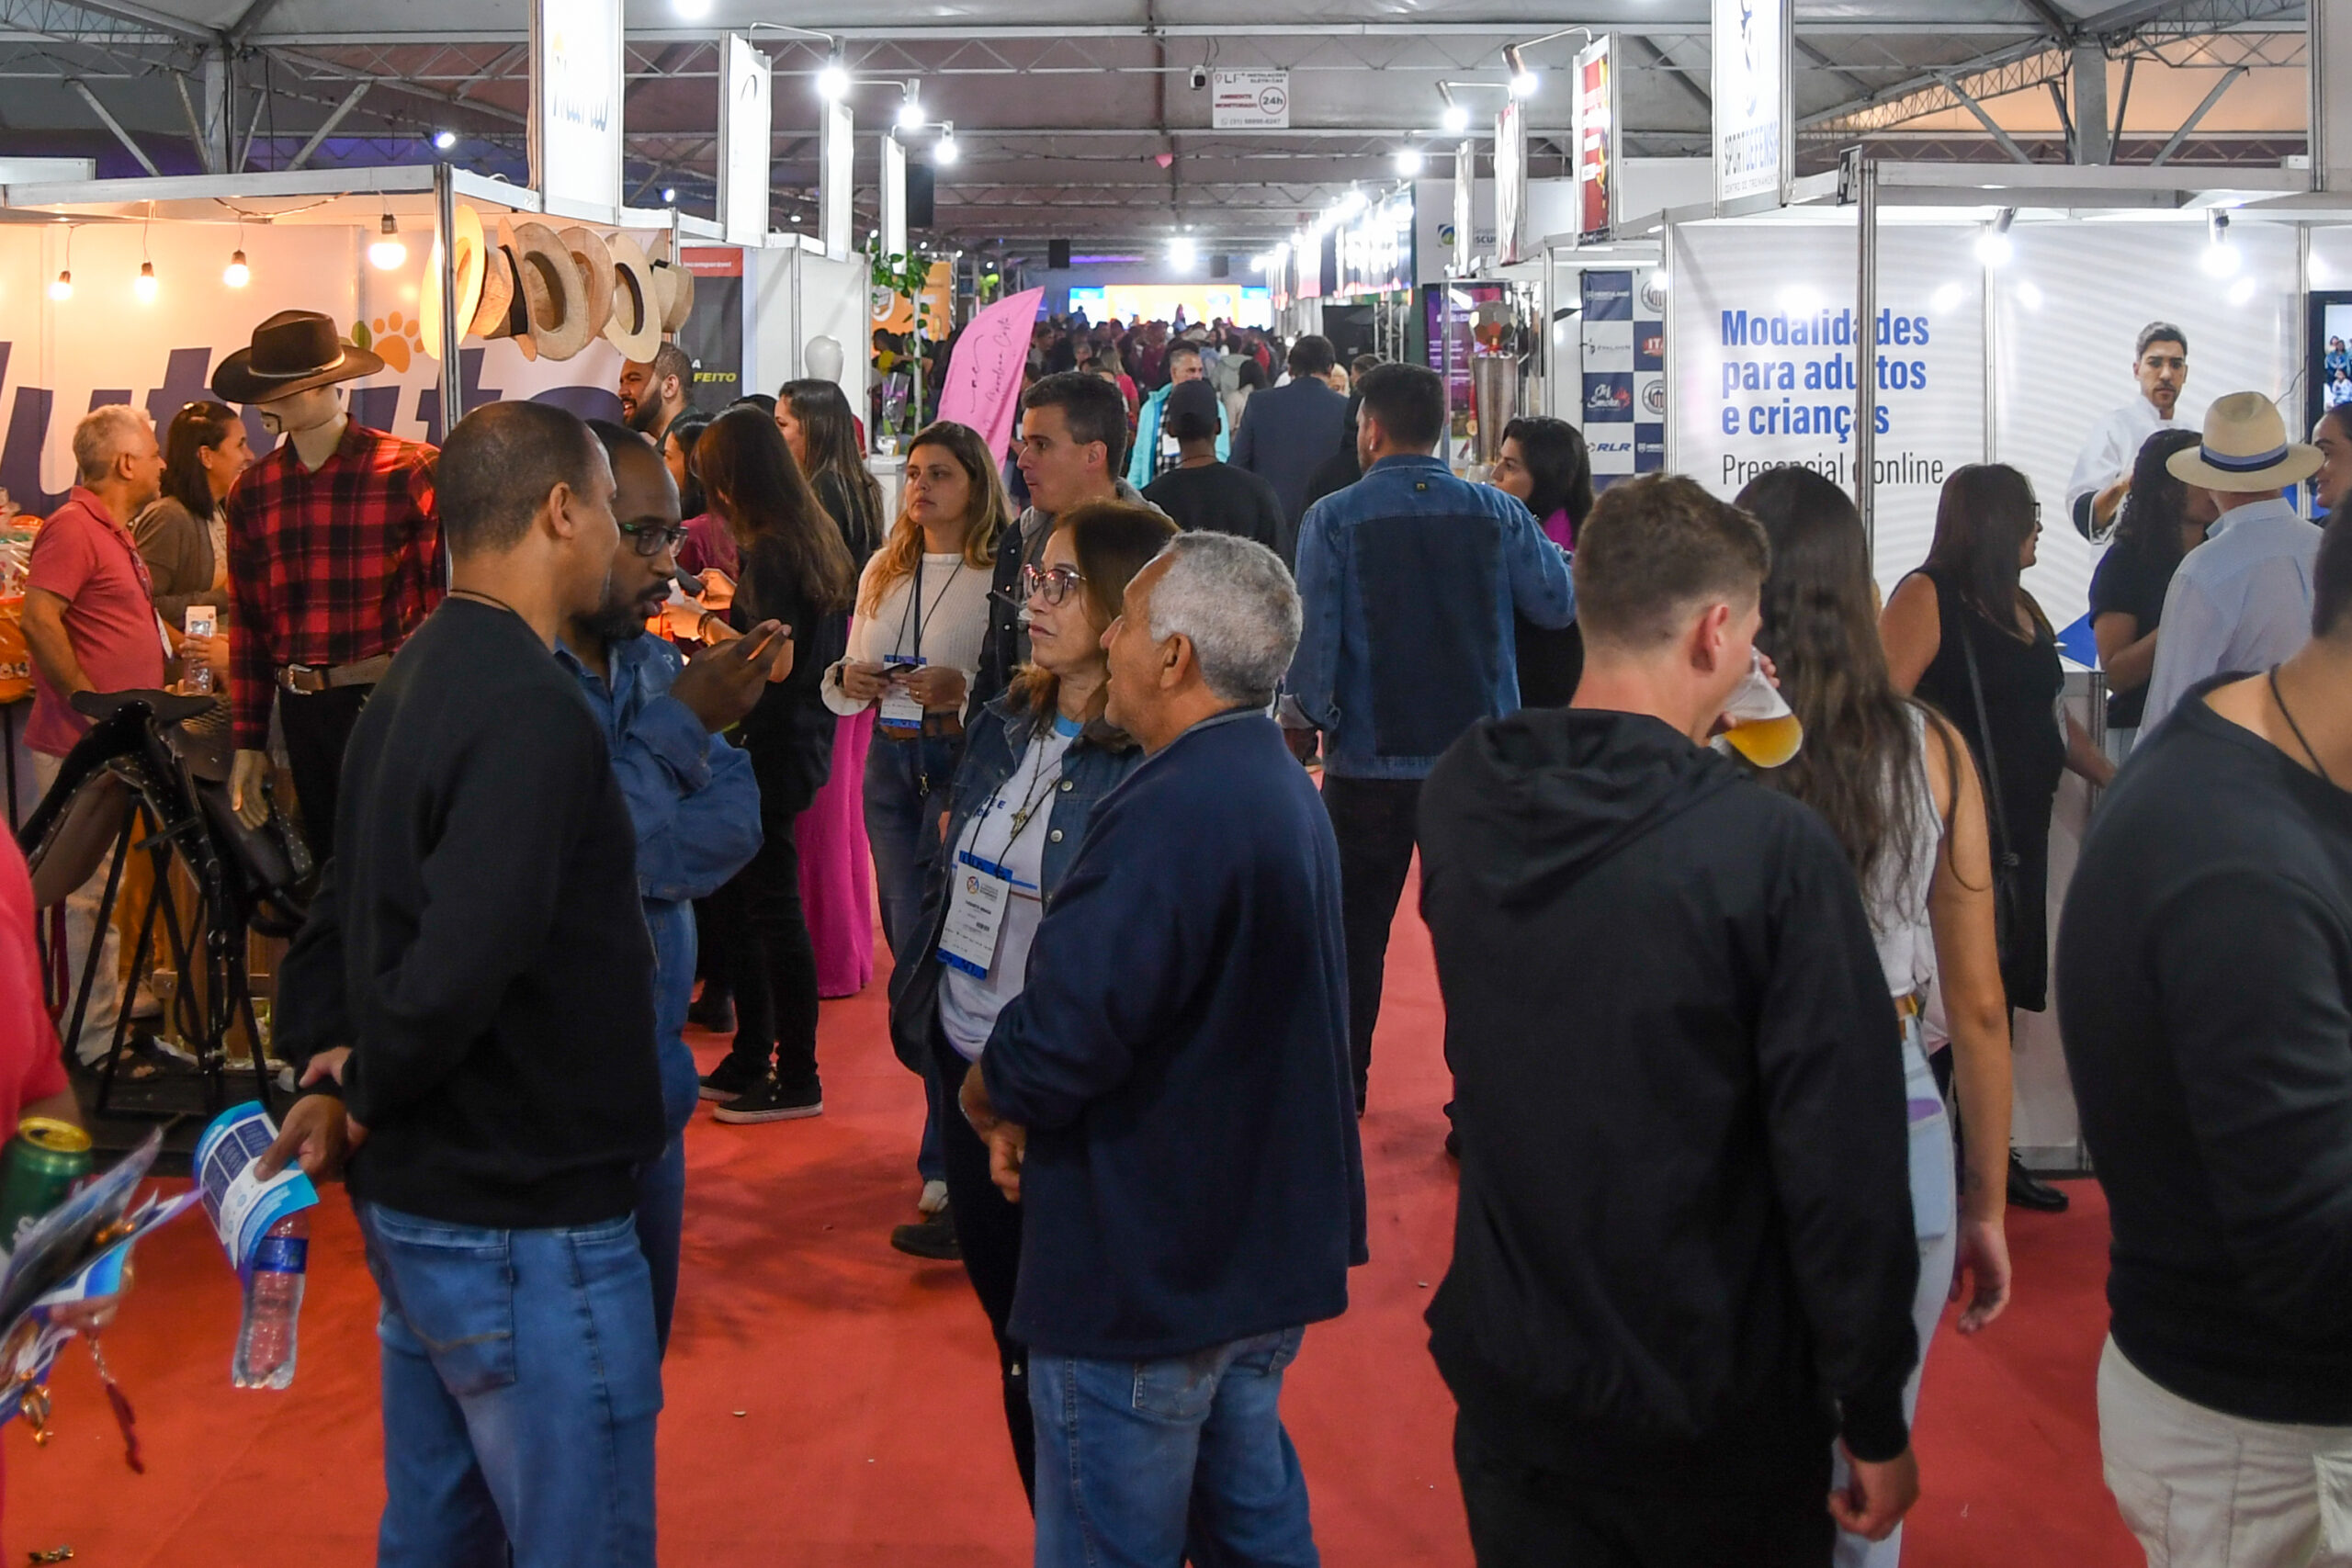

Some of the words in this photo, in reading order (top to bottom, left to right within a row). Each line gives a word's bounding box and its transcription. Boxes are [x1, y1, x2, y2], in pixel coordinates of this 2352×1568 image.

[1262, 96, 1283, 106] 24h
[1722, 361, 1795, 399] para
[1804, 352, 1927, 389] adutos
[1722, 406, 1739, 434] e
[1748, 398, 1890, 444] criançs
[1597, 443, 1631, 451] RLR
[1873, 451, 1943, 484] online
